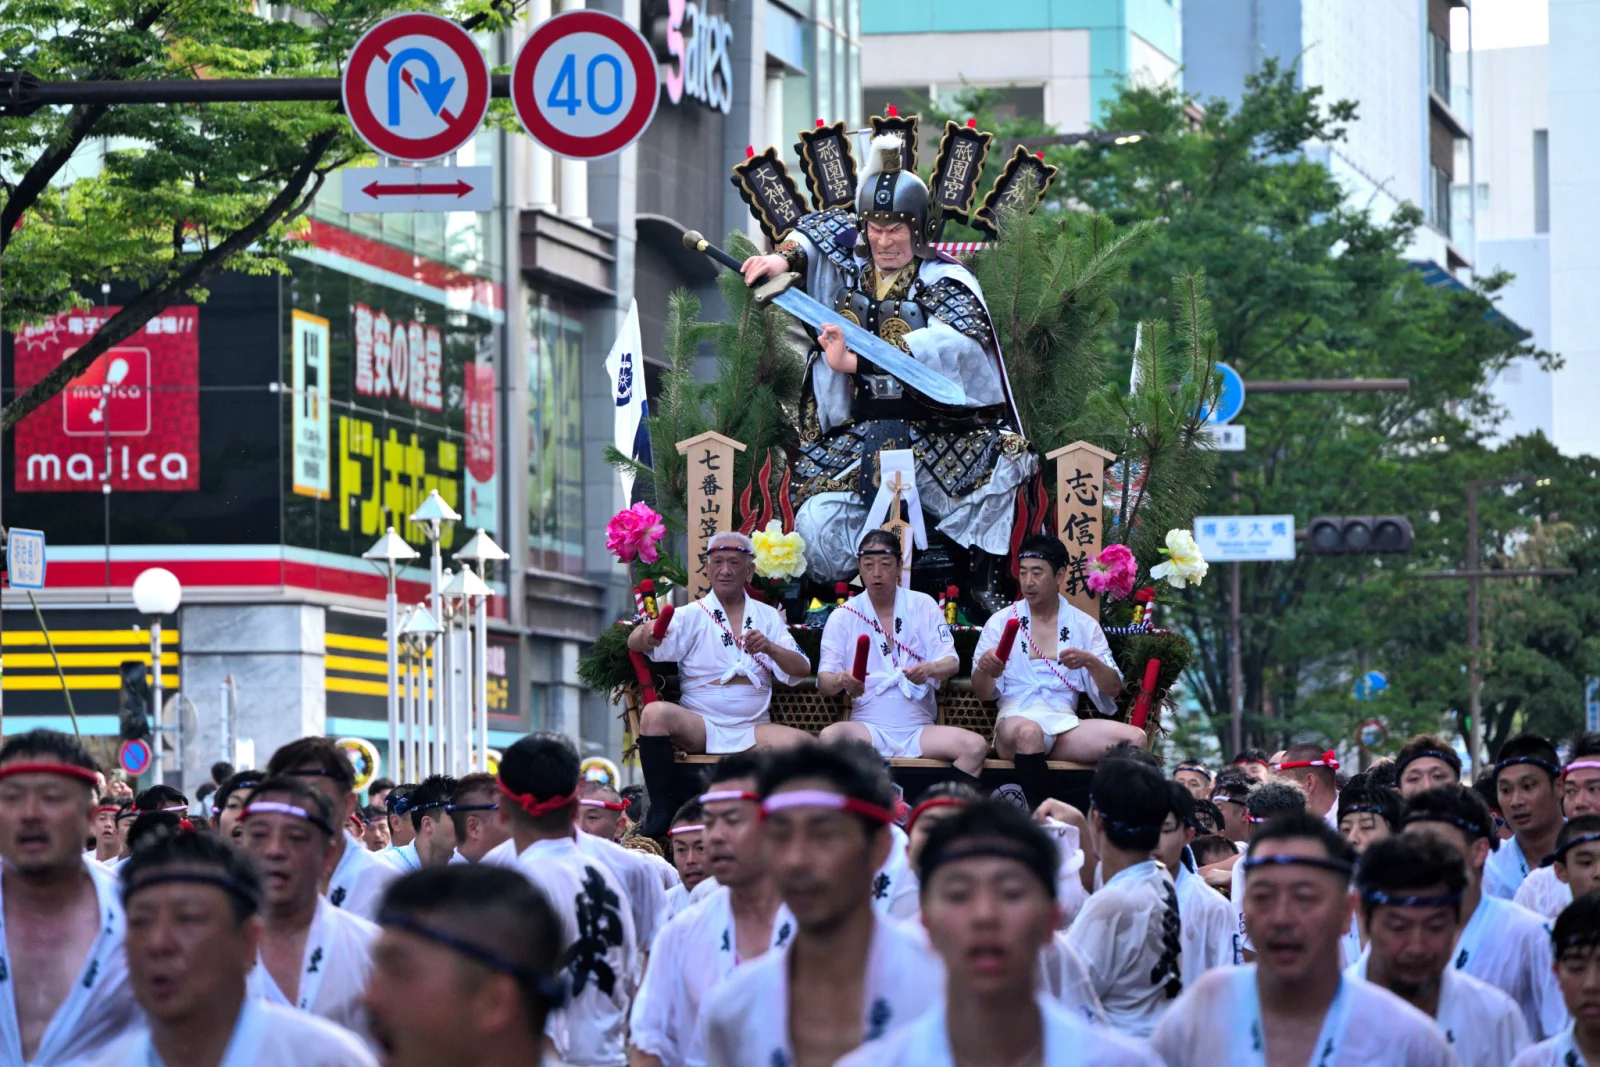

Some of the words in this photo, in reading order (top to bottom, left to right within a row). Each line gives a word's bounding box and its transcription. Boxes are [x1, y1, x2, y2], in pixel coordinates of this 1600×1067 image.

[547, 53, 623, 116] 40
[756, 167, 796, 223] 大神宮
[817, 139, 849, 199] 祇園宮
[944, 141, 974, 200] 祇園宮
[355, 302, 444, 413] 驚安の殿堂
[1062, 468, 1100, 600] 志信義
